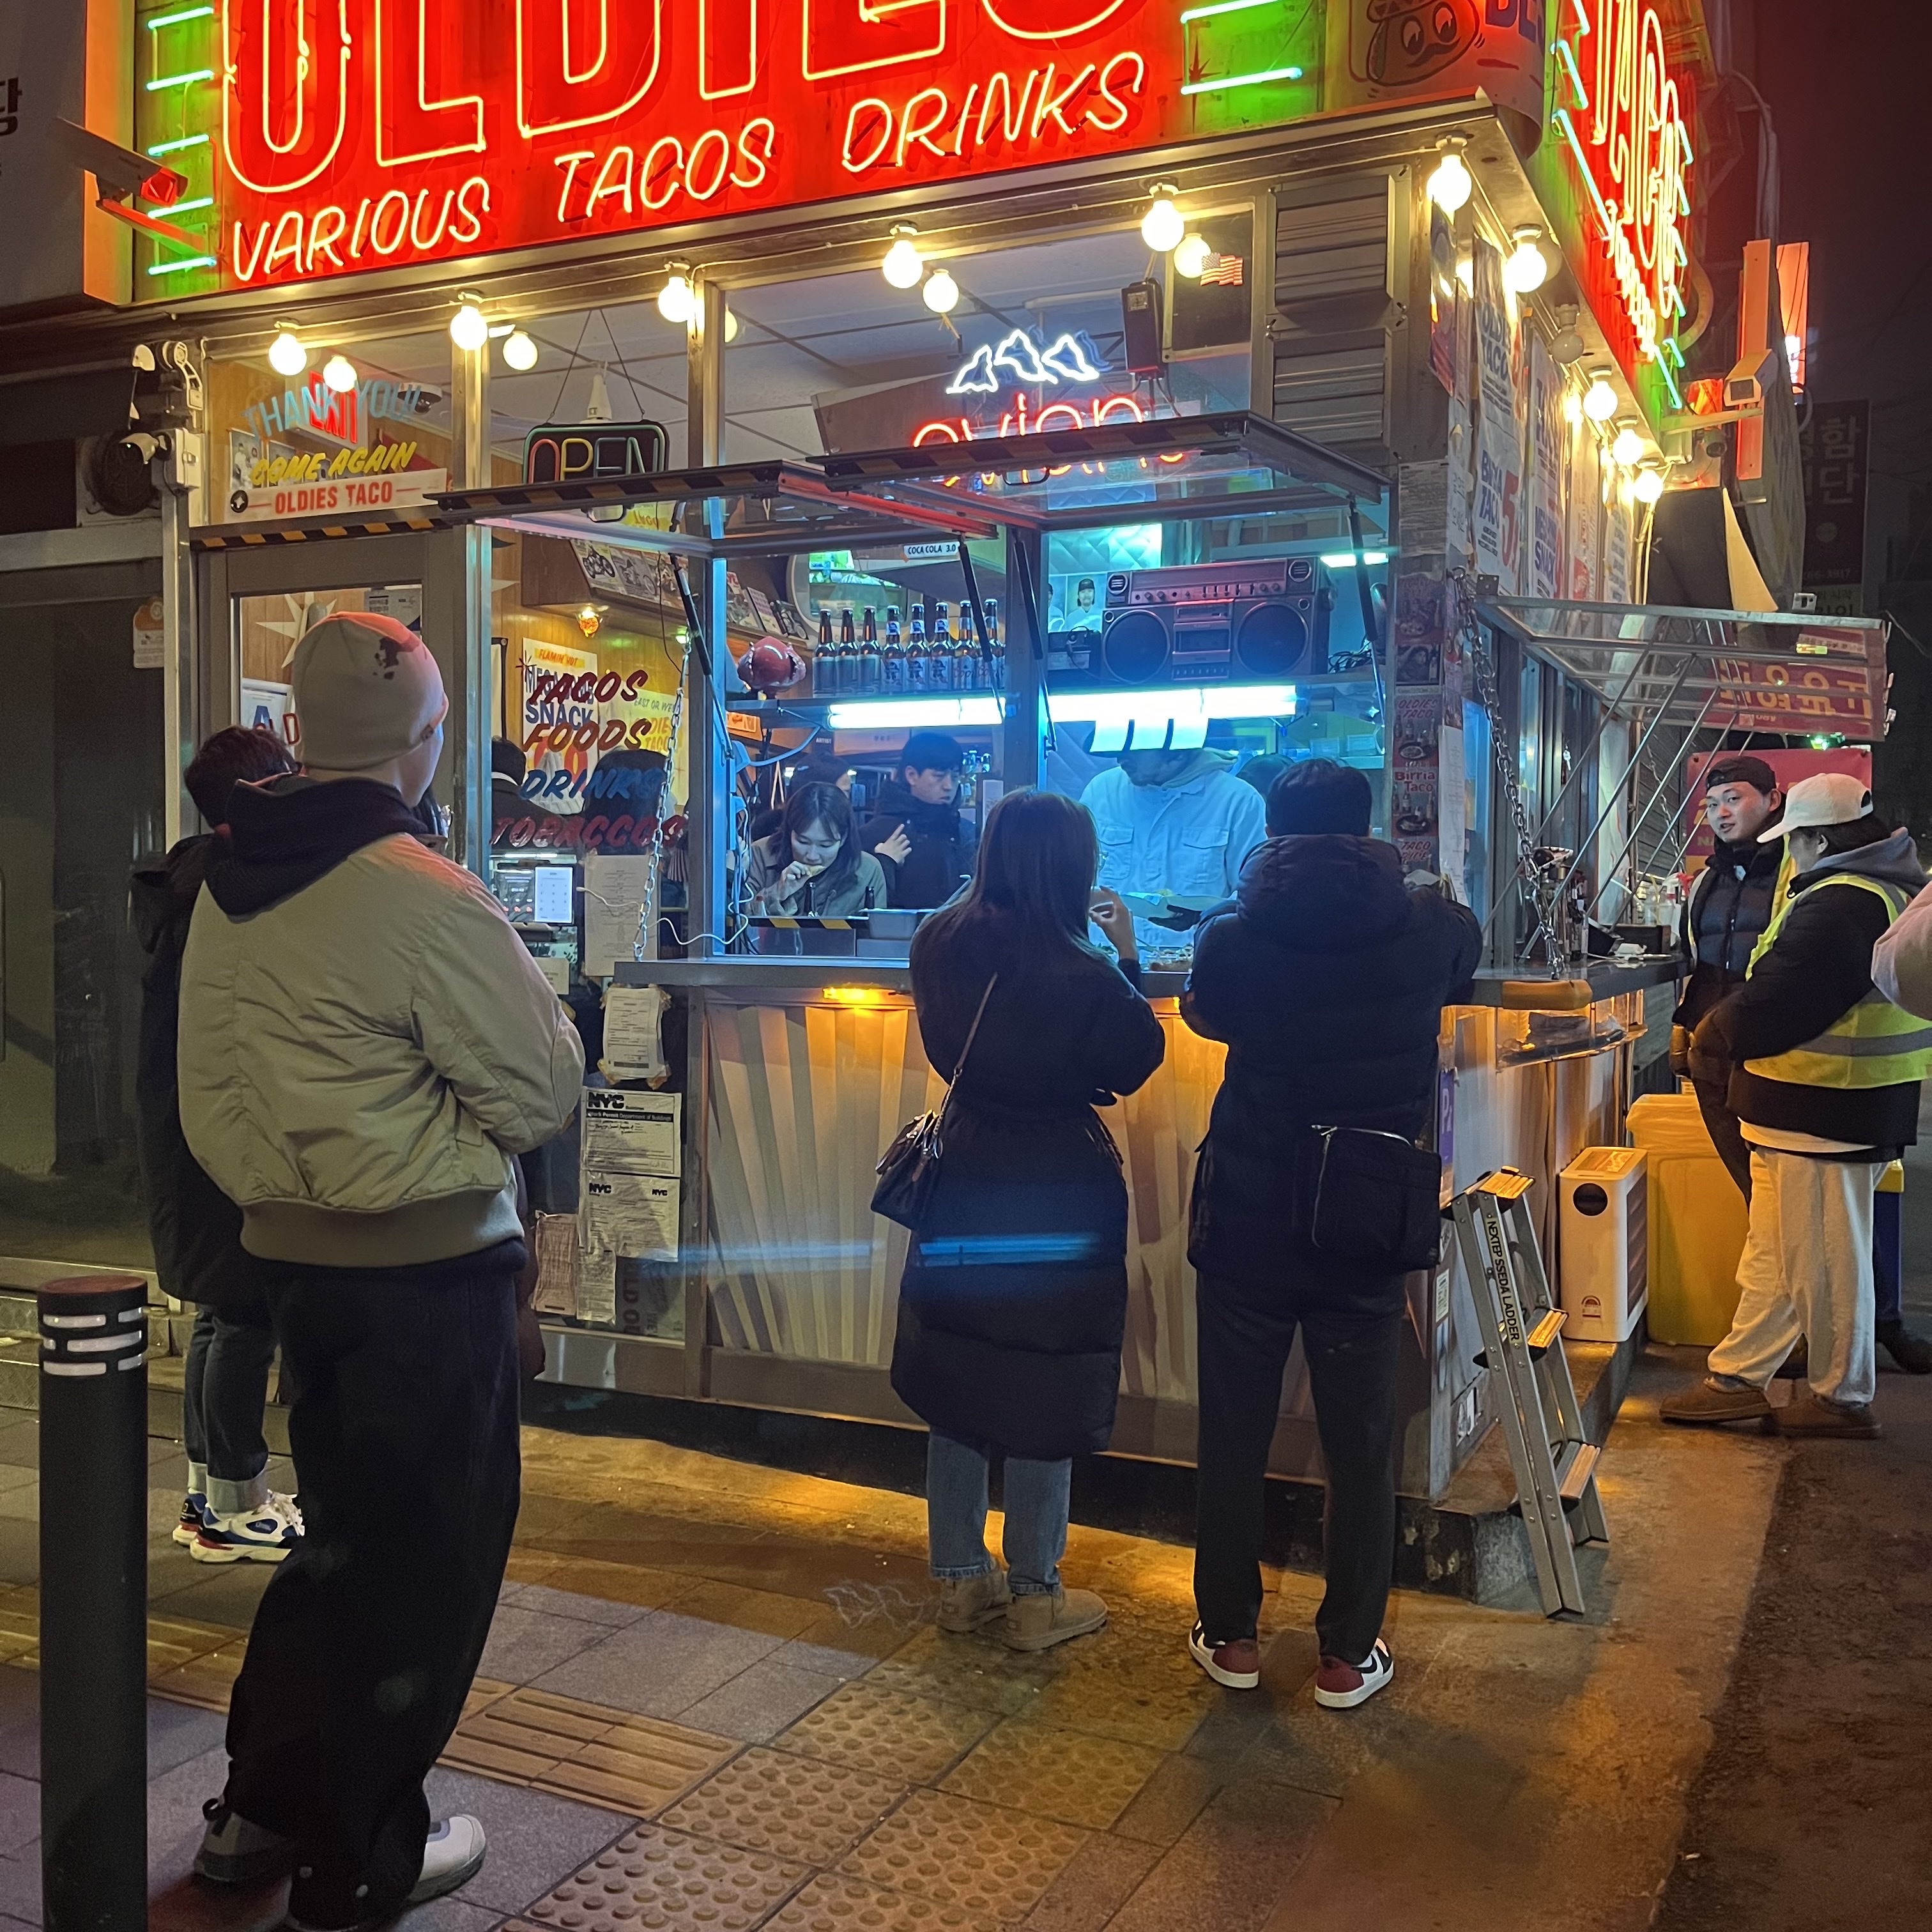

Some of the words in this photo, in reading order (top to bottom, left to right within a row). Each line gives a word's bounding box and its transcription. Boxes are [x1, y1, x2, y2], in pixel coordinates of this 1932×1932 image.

[234, 176, 491, 281] VARIOUS
[554, 118, 775, 222] TACOS
[842, 52, 1144, 172] DRINKS
[241, 382, 340, 443] THANK
[250, 453, 325, 486] COME
[328, 441, 417, 477] AGAIN
[528, 436, 659, 484] OPEN
[275, 486, 337, 514] OLDIES
[346, 481, 392, 507] TACO
[908, 546, 924, 555] COCA
[925, 545, 942, 553] COLA
[946, 544, 956, 552] 3.0
[528, 670, 648, 705] TACOS
[525, 700, 594, 730] SNACK
[634, 697, 648, 709] EAST
[652, 700, 660, 710] OR
[1403, 710, 1434, 719] TACO
[523, 718, 652, 752] FOODS
[518, 767, 666, 799] DRINKS
[1395, 771, 1436, 781] Birria
[1404, 781, 1434, 792] Taco
[1401, 841, 1431, 850] TACO
[588, 1092, 624, 1109] NYC
[589, 1183, 611, 1193] NYC
[1487, 1221, 1502, 1257] NEXTEP
[1495, 1259, 1510, 1294] SSEDA
[1503, 1296, 1521, 1341] LADDER
